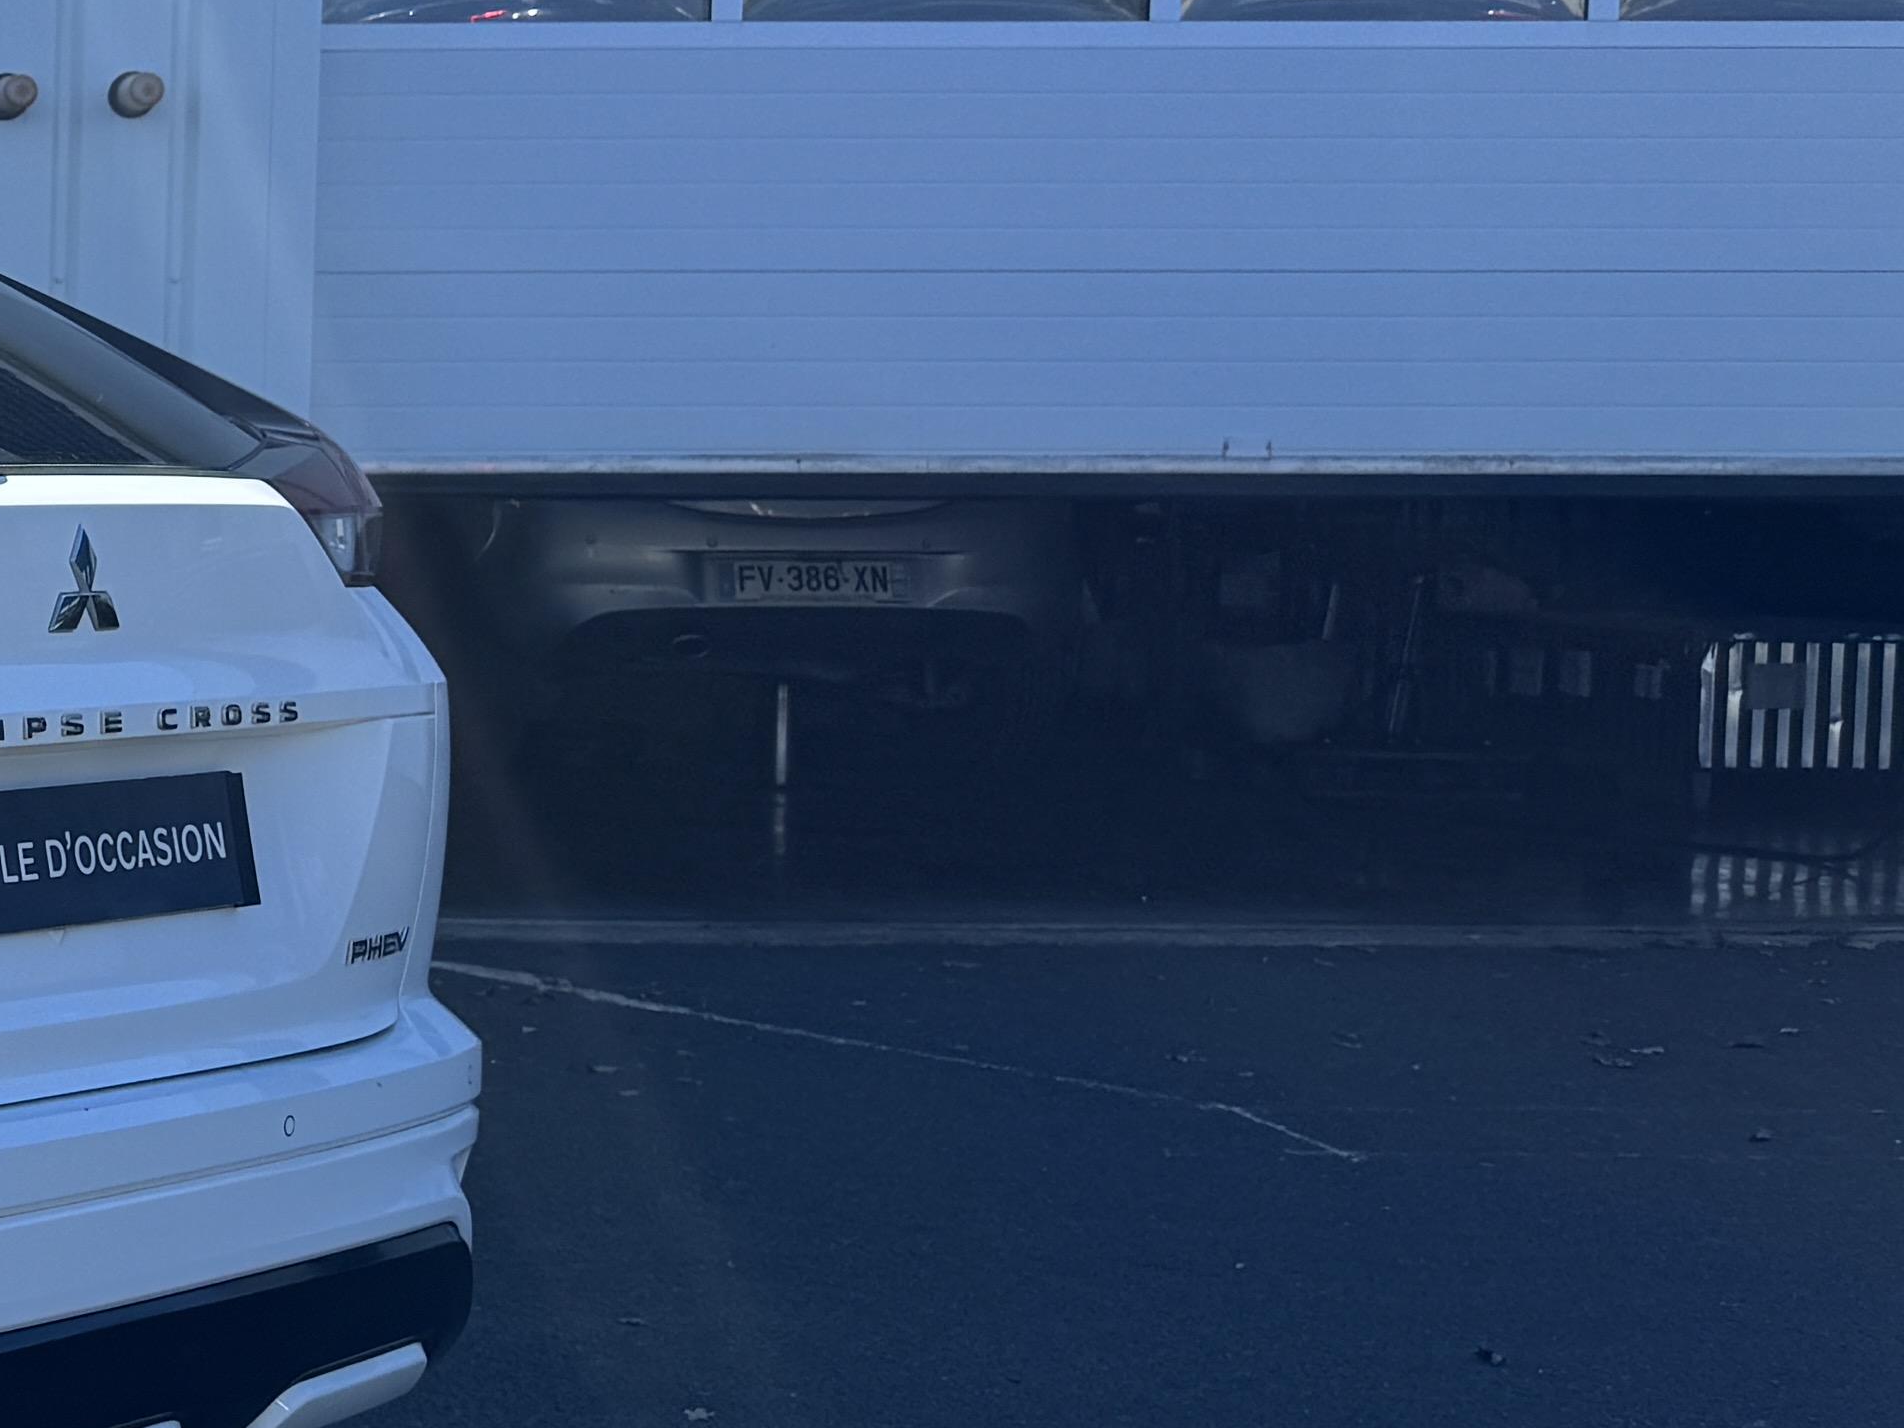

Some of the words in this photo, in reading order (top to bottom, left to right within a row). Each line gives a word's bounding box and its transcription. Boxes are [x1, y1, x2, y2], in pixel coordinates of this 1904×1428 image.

[156, 701, 299, 731] CROSS
[45, 821, 227, 878] D'OCCASION
[345, 926, 410, 965] PHEV
